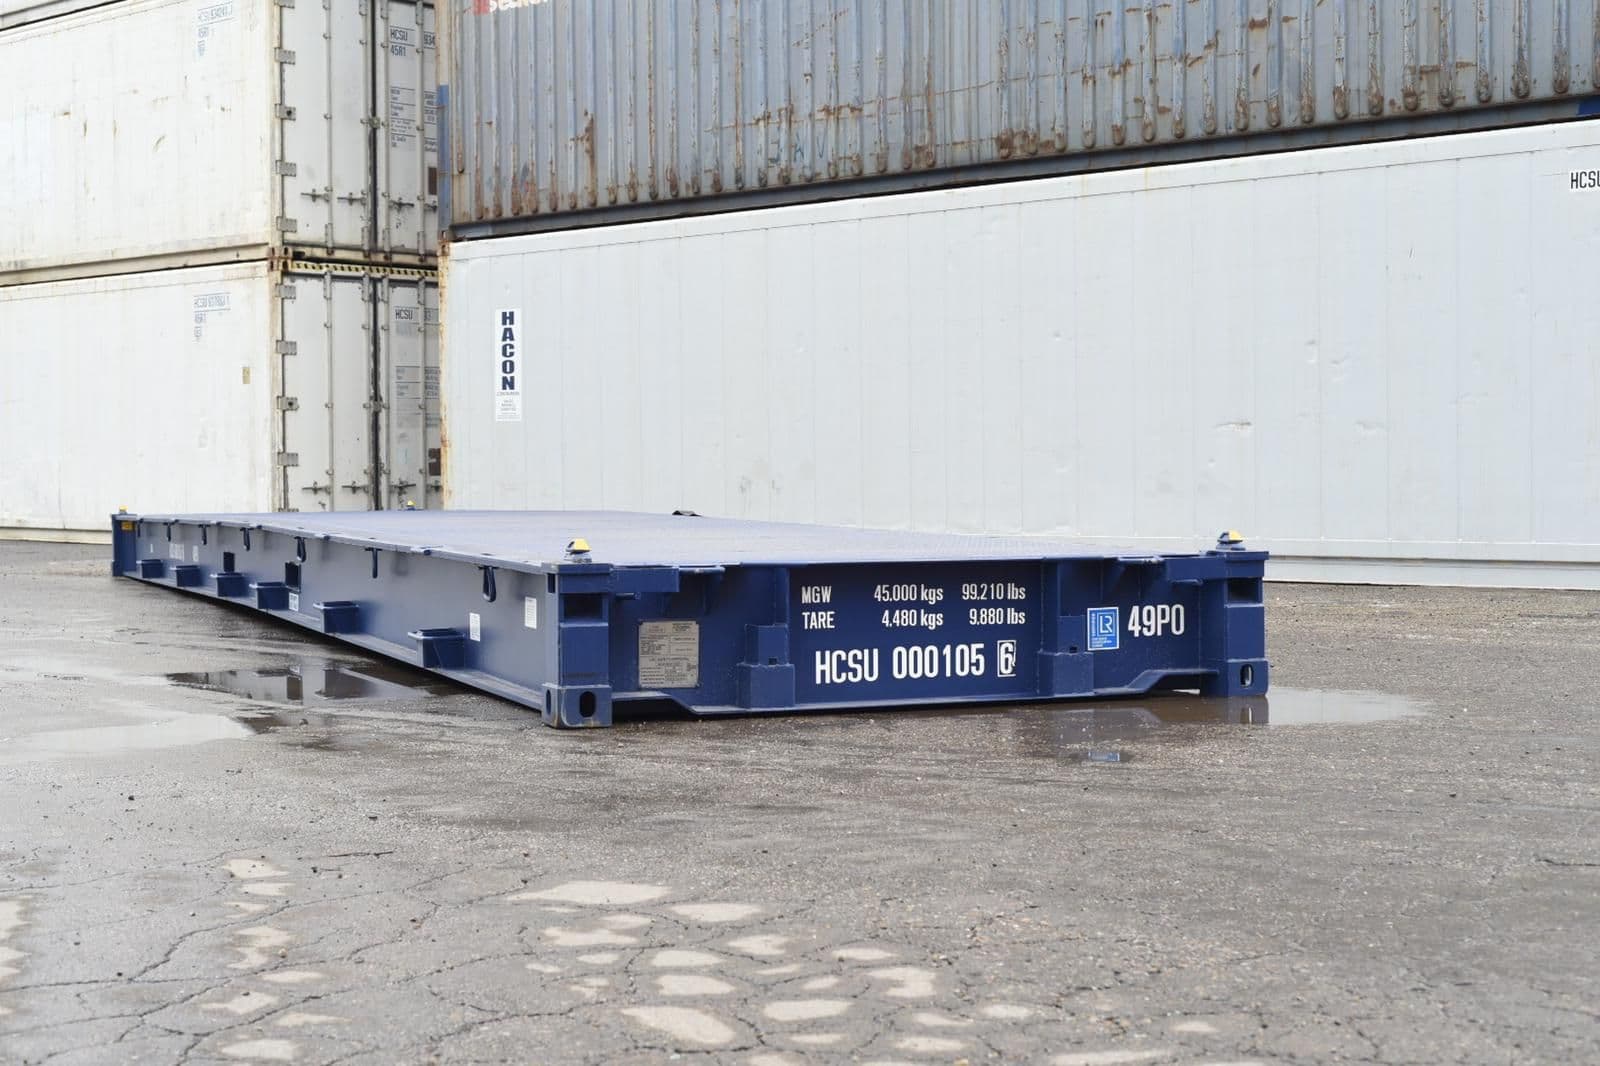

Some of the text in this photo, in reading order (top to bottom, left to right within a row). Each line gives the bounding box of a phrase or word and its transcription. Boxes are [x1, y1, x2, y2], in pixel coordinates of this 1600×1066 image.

[390, 29, 408, 41] HCSU
[1570, 171, 1600, 189] HCSU
[394, 309, 413, 320] HCSU
[501, 311, 515, 391] HACON
[801, 585, 832, 604] MGW
[920, 584, 944, 605] kgs
[1007, 582, 1026, 600] lbs
[802, 611, 835, 630] TARE
[920, 609, 944, 631] kgs
[1007, 607, 1026, 625] lbs
[815, 648, 879, 685] HCSU
[893, 643, 985, 680] 000105
